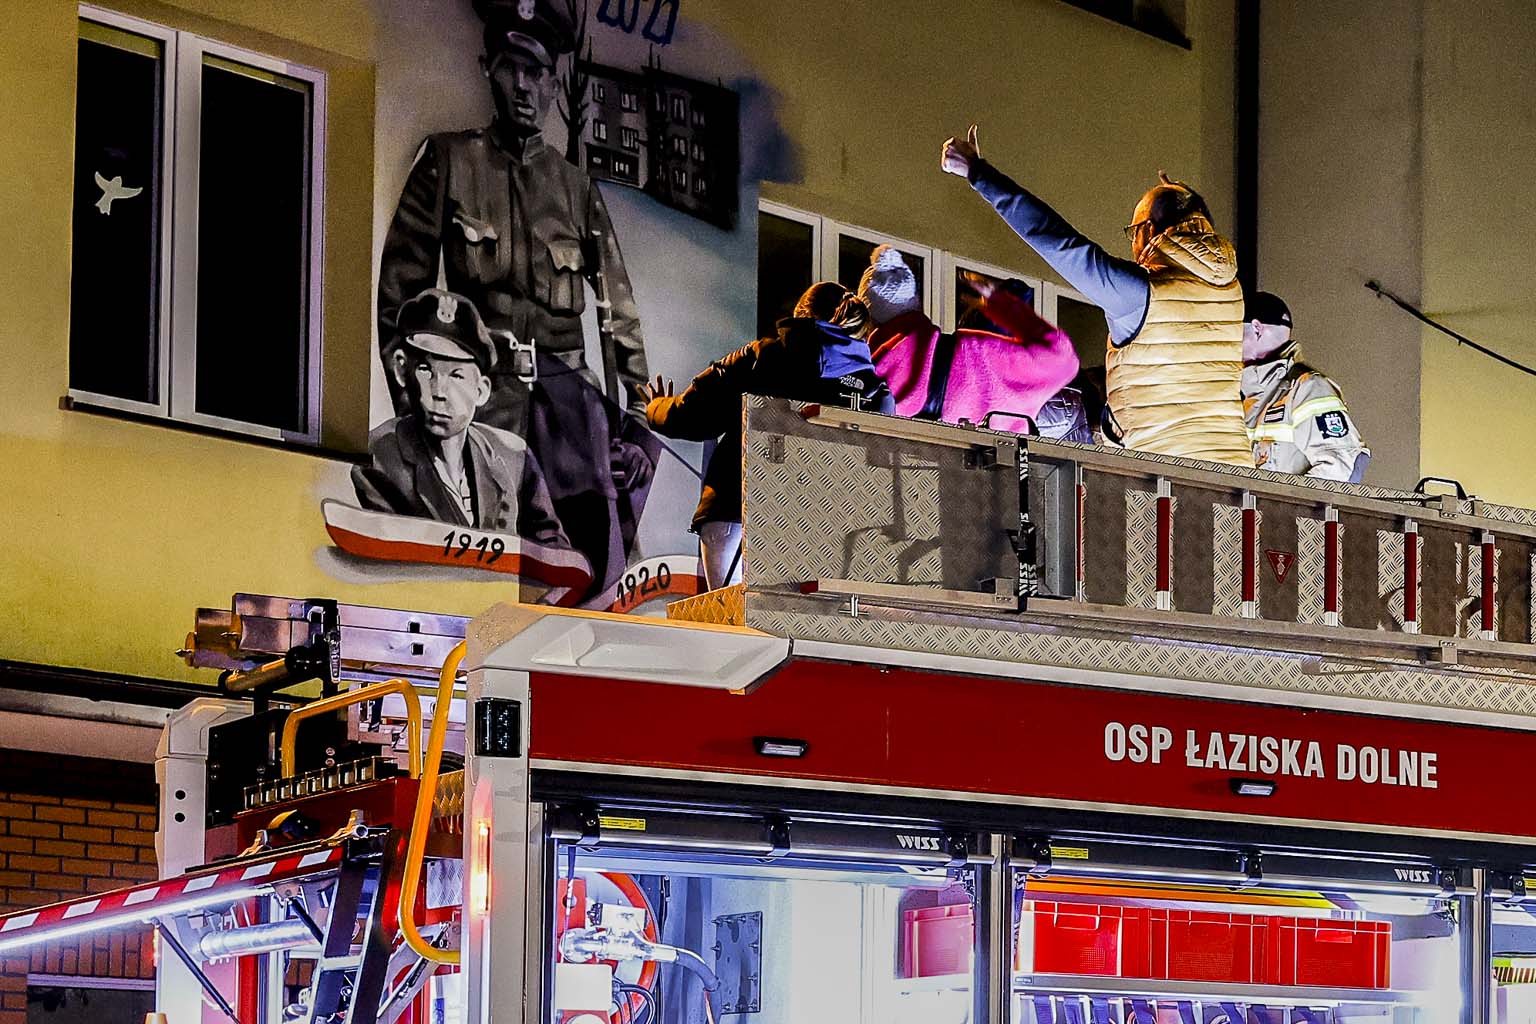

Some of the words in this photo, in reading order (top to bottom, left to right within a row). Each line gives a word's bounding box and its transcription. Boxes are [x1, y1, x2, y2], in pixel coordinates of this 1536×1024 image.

[443, 530, 505, 565] 1919
[616, 562, 672, 608] 1920
[1104, 721, 1173, 764] OSP
[1185, 729, 1325, 779] ŁAZISKA
[1337, 744, 1438, 789] DOLNE
[896, 834, 940, 850] WISS
[1393, 868, 1430, 883] WISS
